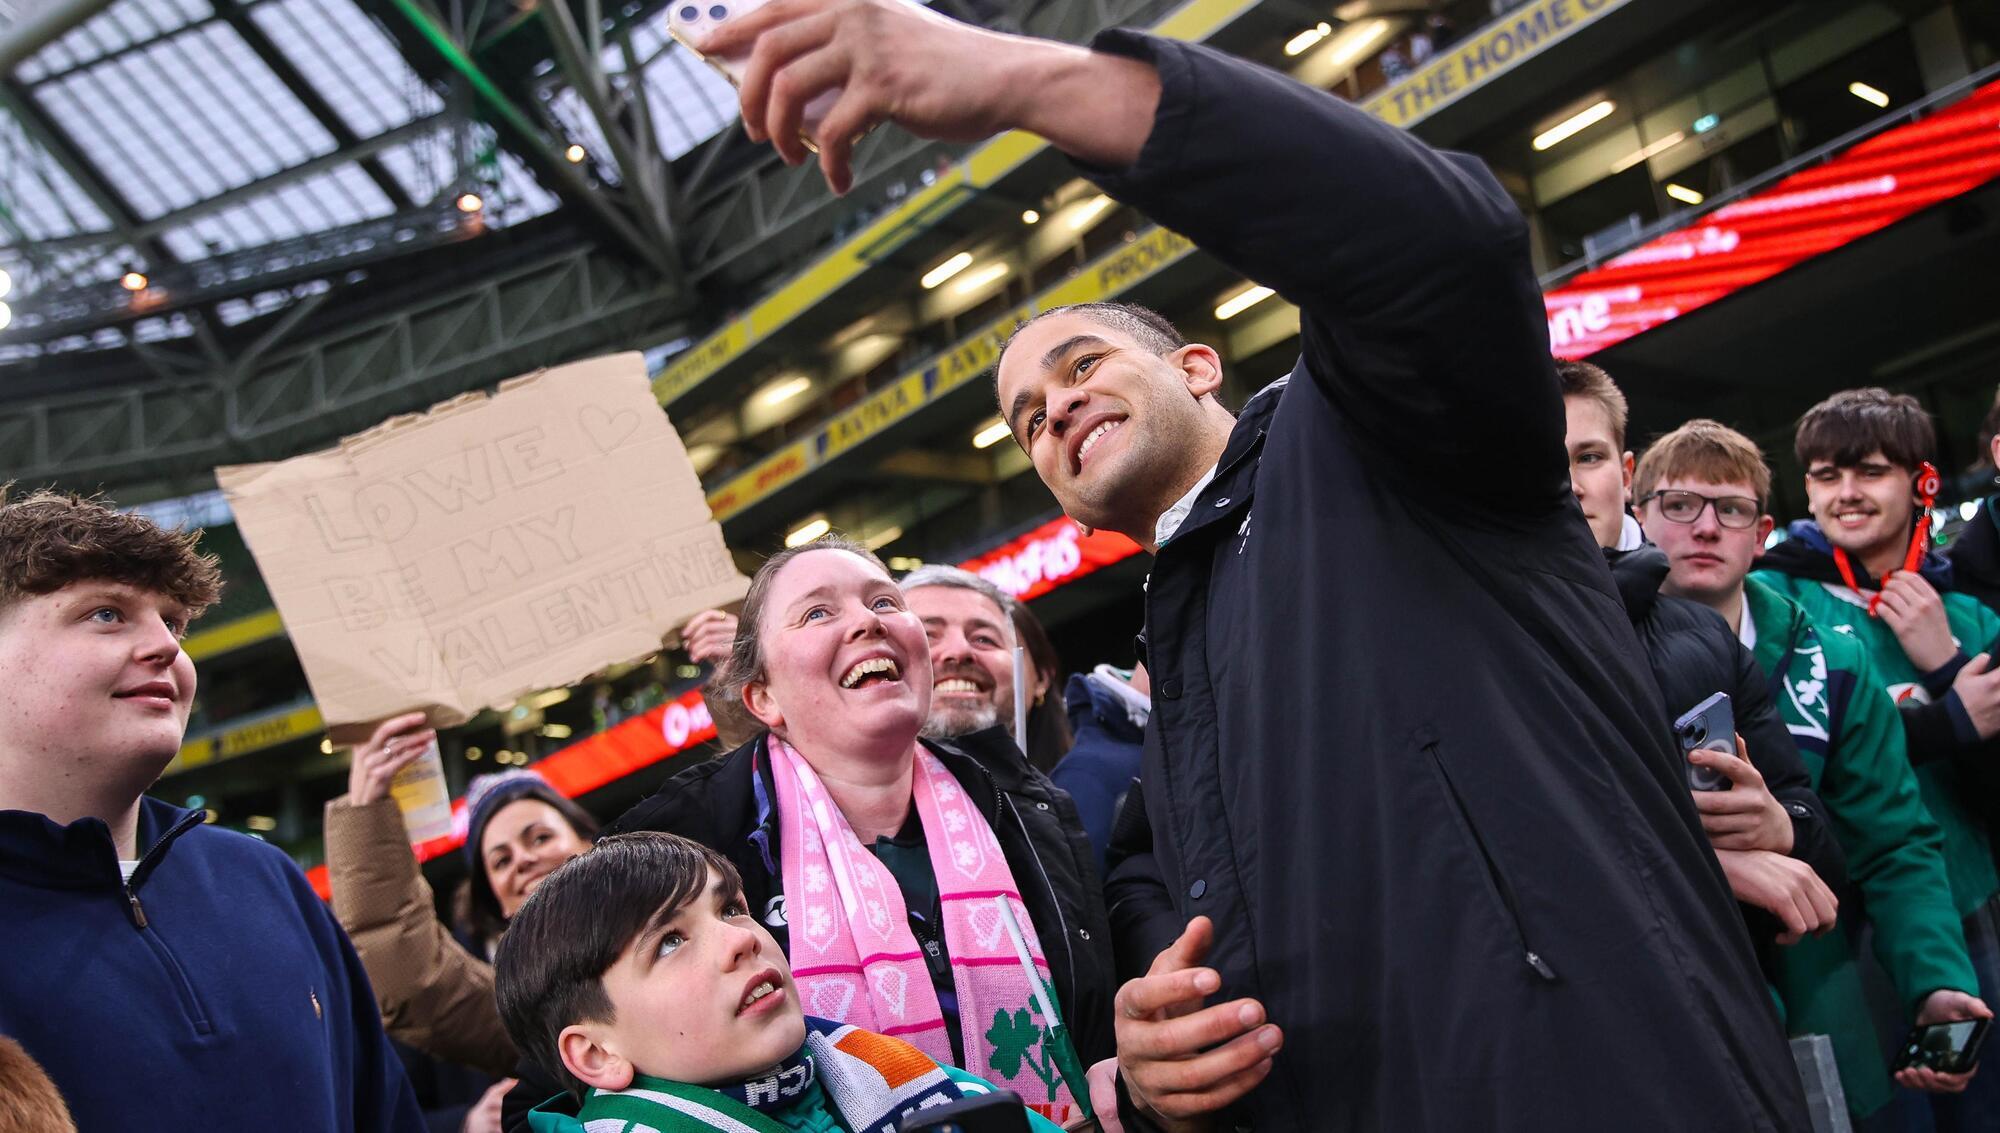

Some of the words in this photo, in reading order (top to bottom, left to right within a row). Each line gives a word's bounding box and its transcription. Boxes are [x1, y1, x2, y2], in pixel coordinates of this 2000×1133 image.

[1391, 63, 1458, 119] THE
[1461, 0, 1572, 81] HOME
[1551, 295, 1610, 346] ne
[303, 426, 567, 554] LOWE
[322, 561, 437, 632] BE
[450, 505, 582, 596] MY
[370, 540, 738, 694] VALENTINE
